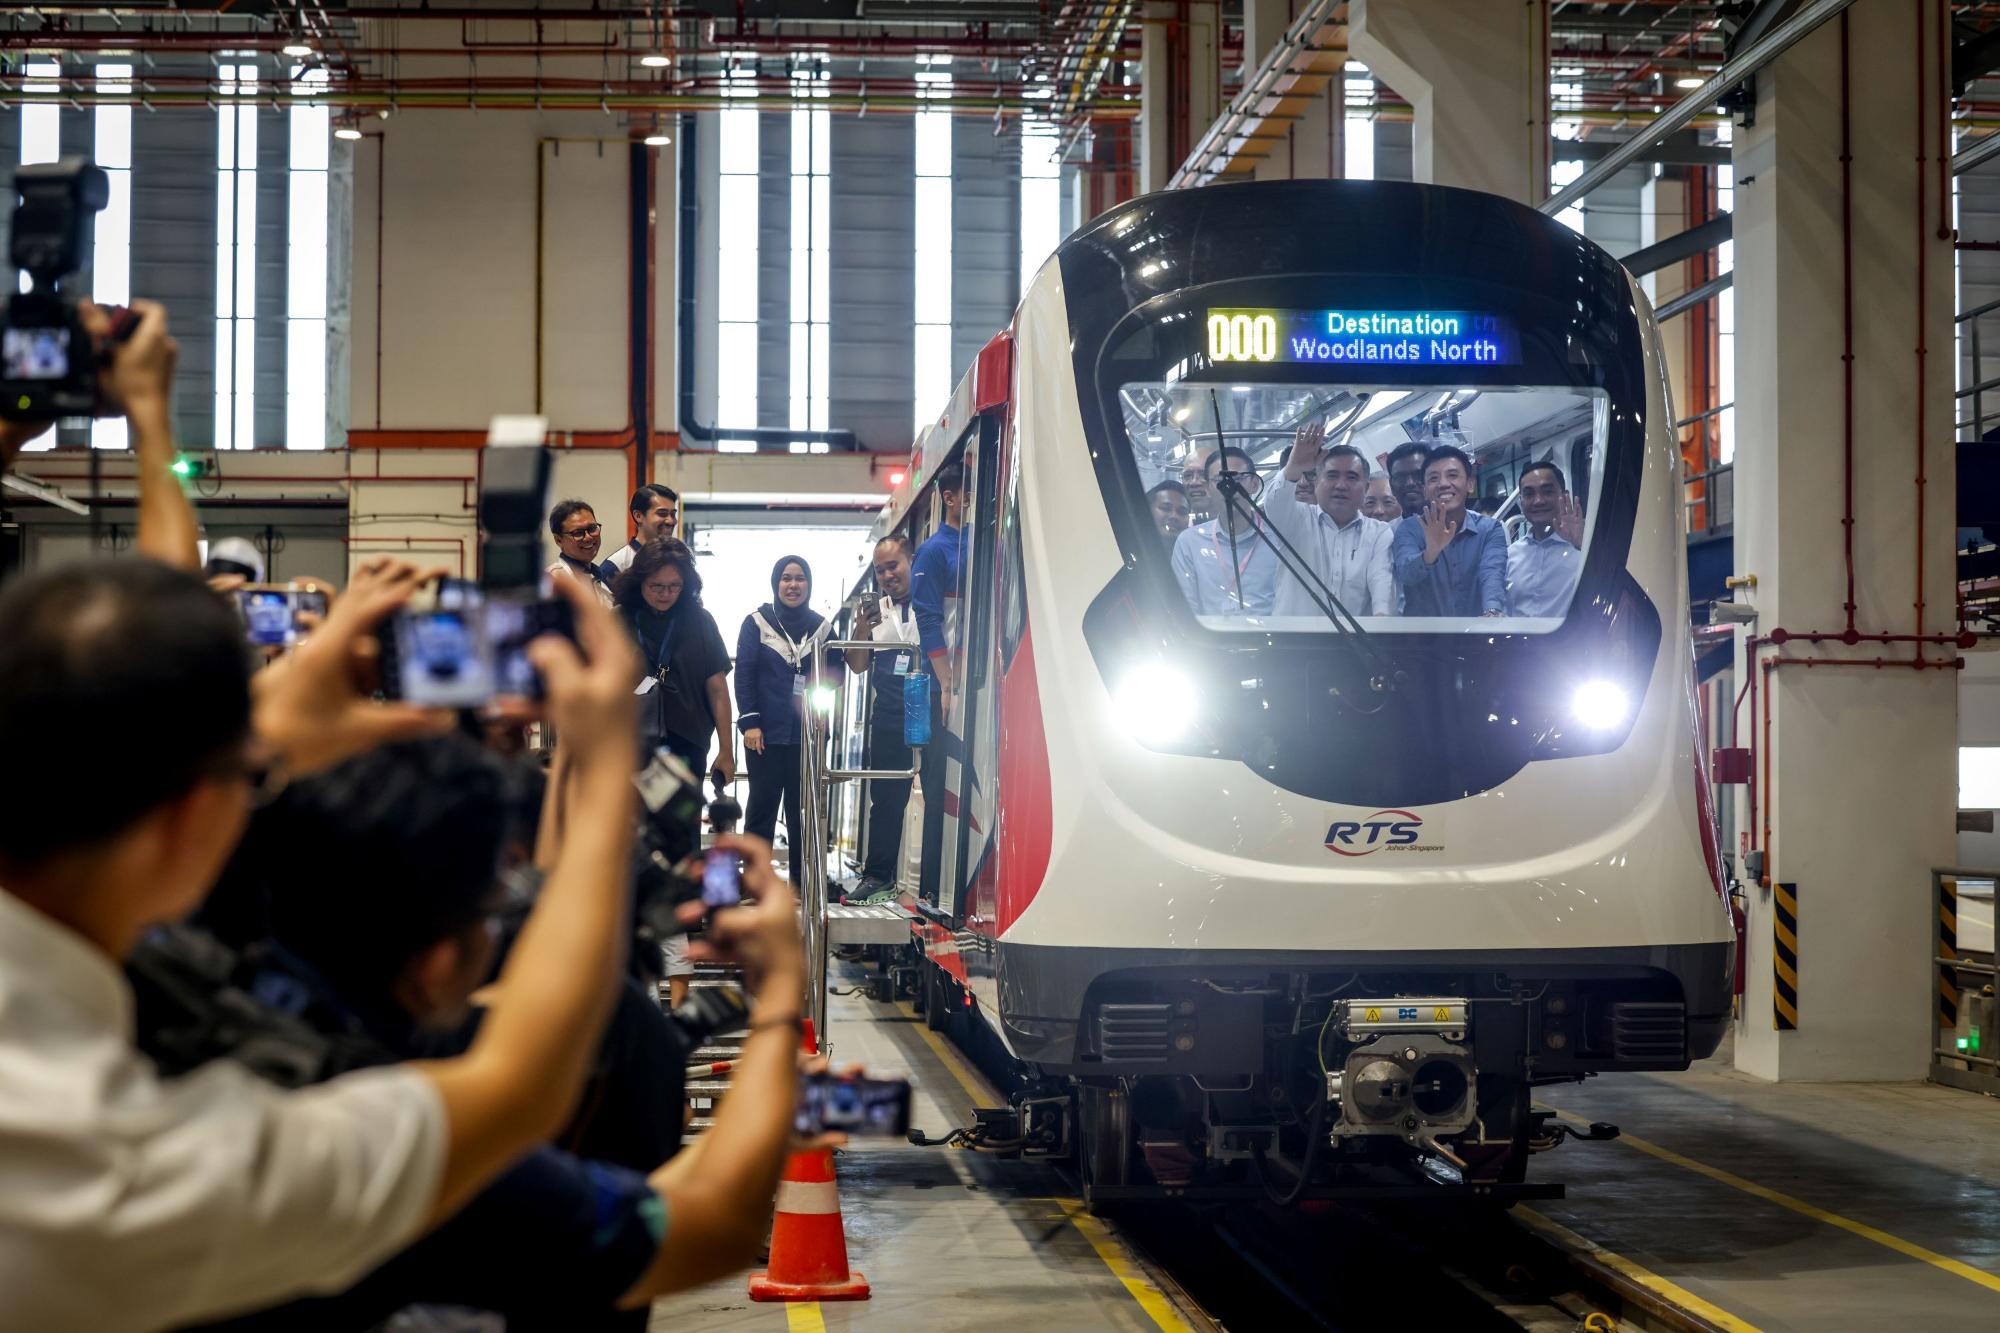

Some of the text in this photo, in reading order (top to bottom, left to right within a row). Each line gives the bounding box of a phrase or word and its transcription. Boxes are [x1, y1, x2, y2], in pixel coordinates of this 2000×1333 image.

[1328, 313, 1459, 335] Destination
[1207, 314, 1276, 361] 000
[1292, 338, 1497, 361] Woodlands North
[1324, 822, 1423, 844] RTS
